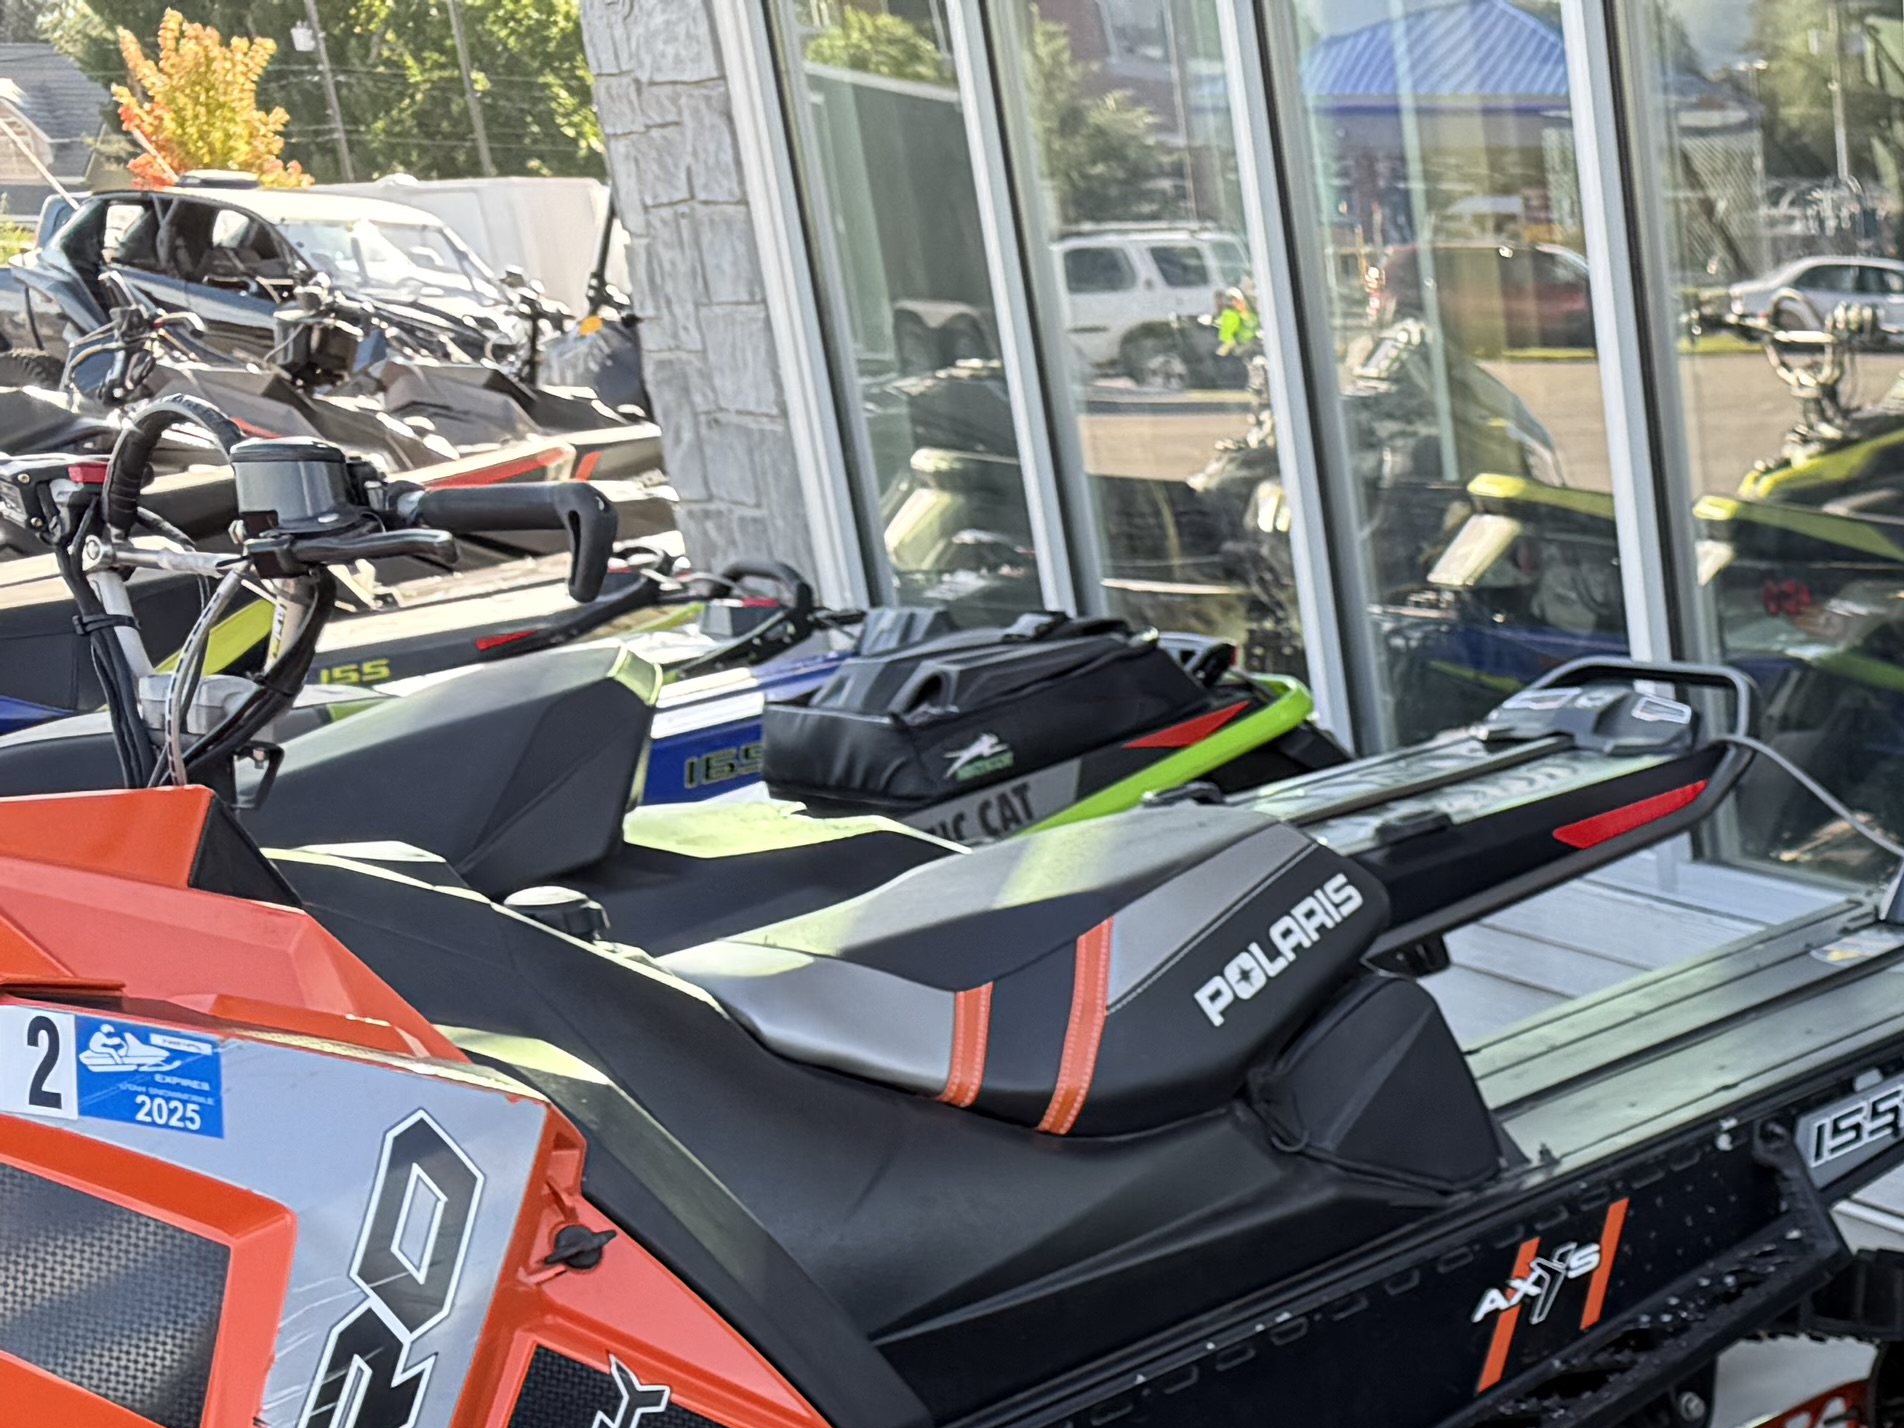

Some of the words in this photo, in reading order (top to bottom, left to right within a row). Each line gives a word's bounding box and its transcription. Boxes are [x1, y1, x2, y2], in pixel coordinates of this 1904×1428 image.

[320, 658, 391, 684] 155
[977, 781, 1035, 836] CAT
[1194, 873, 1363, 1027] POLARIS
[27, 1015, 62, 1109] 2
[135, 1094, 201, 1130] 2025
[1808, 1083, 1904, 1168] 155
